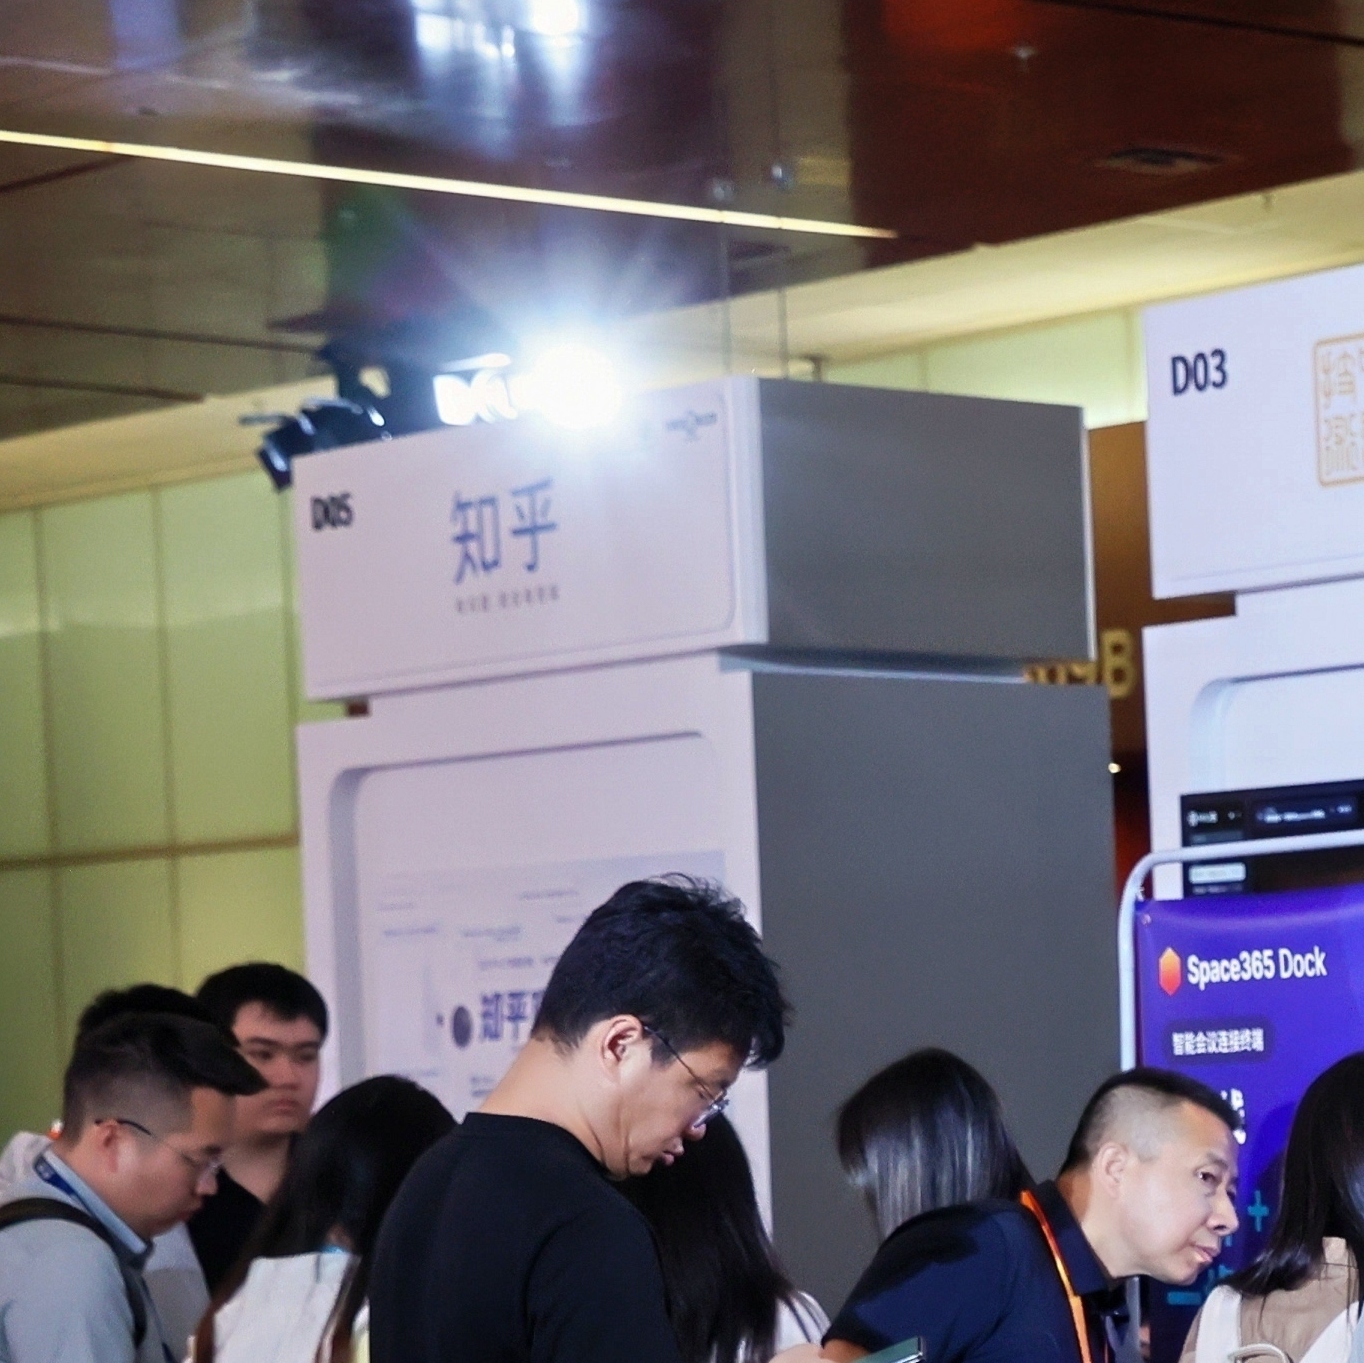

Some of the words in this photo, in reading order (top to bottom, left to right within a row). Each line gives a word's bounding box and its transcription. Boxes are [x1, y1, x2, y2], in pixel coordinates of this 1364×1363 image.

[1171, 348, 1228, 397] D03
[310, 492, 355, 530] D05
[451, 475, 558, 585] 知乎
[1187, 947, 1276, 991] Space365
[1278, 945, 1328, 979] Dock
[1171, 1027, 1265, 1057] 智能会议连接终端
